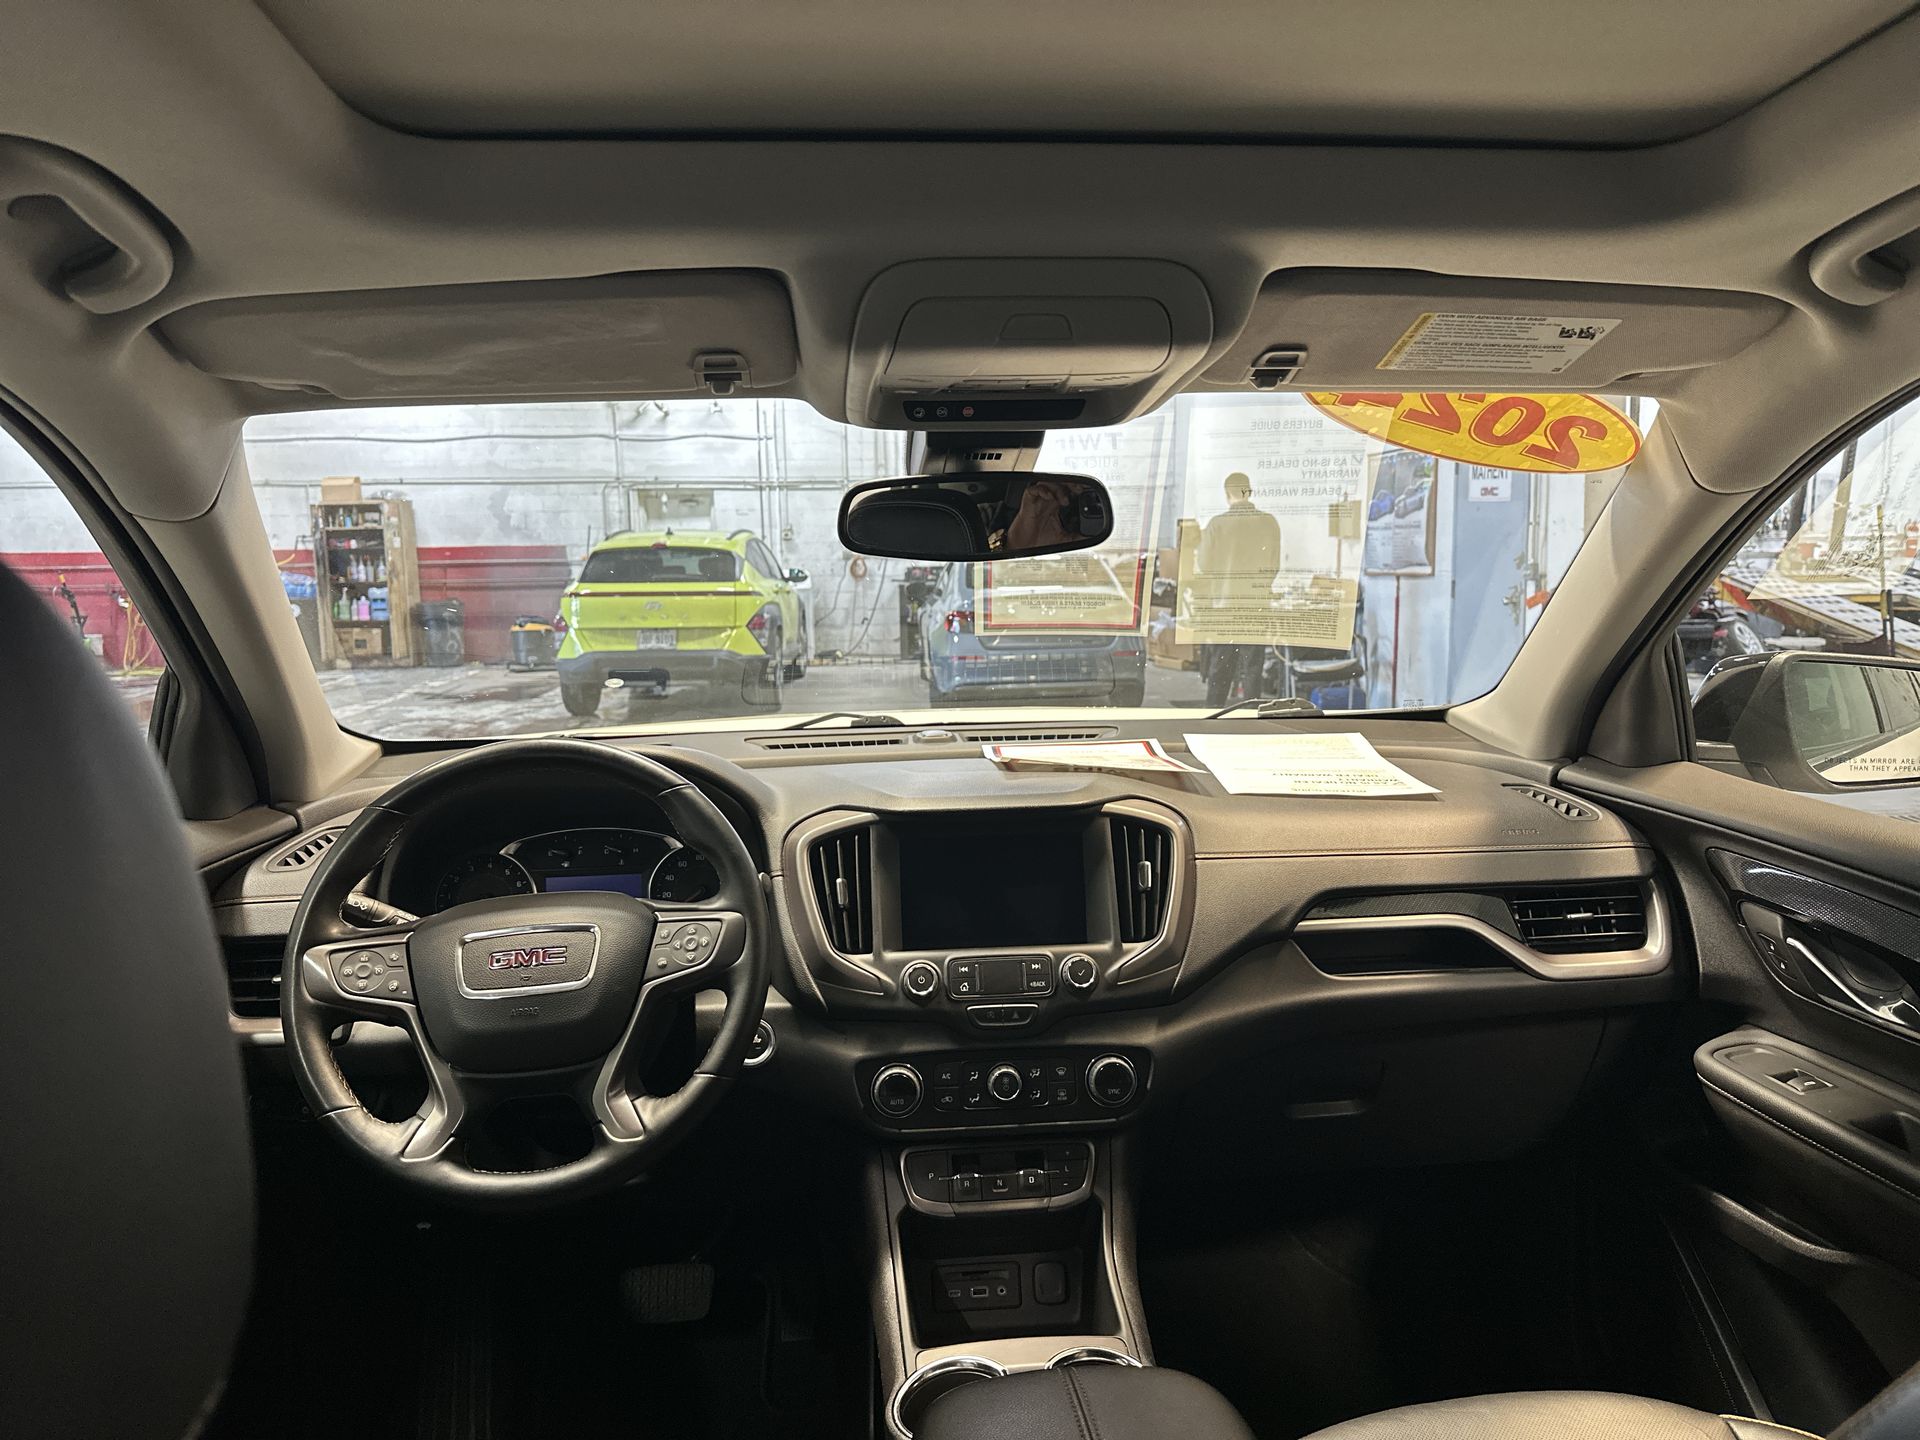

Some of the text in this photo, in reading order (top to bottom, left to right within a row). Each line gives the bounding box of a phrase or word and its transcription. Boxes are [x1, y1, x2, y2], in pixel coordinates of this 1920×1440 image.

[488, 946, 567, 970] GMC
[964, 1180, 970, 1188] R
[996, 1179, 1003, 1187] N
[1028, 1176, 1035, 1184] D
